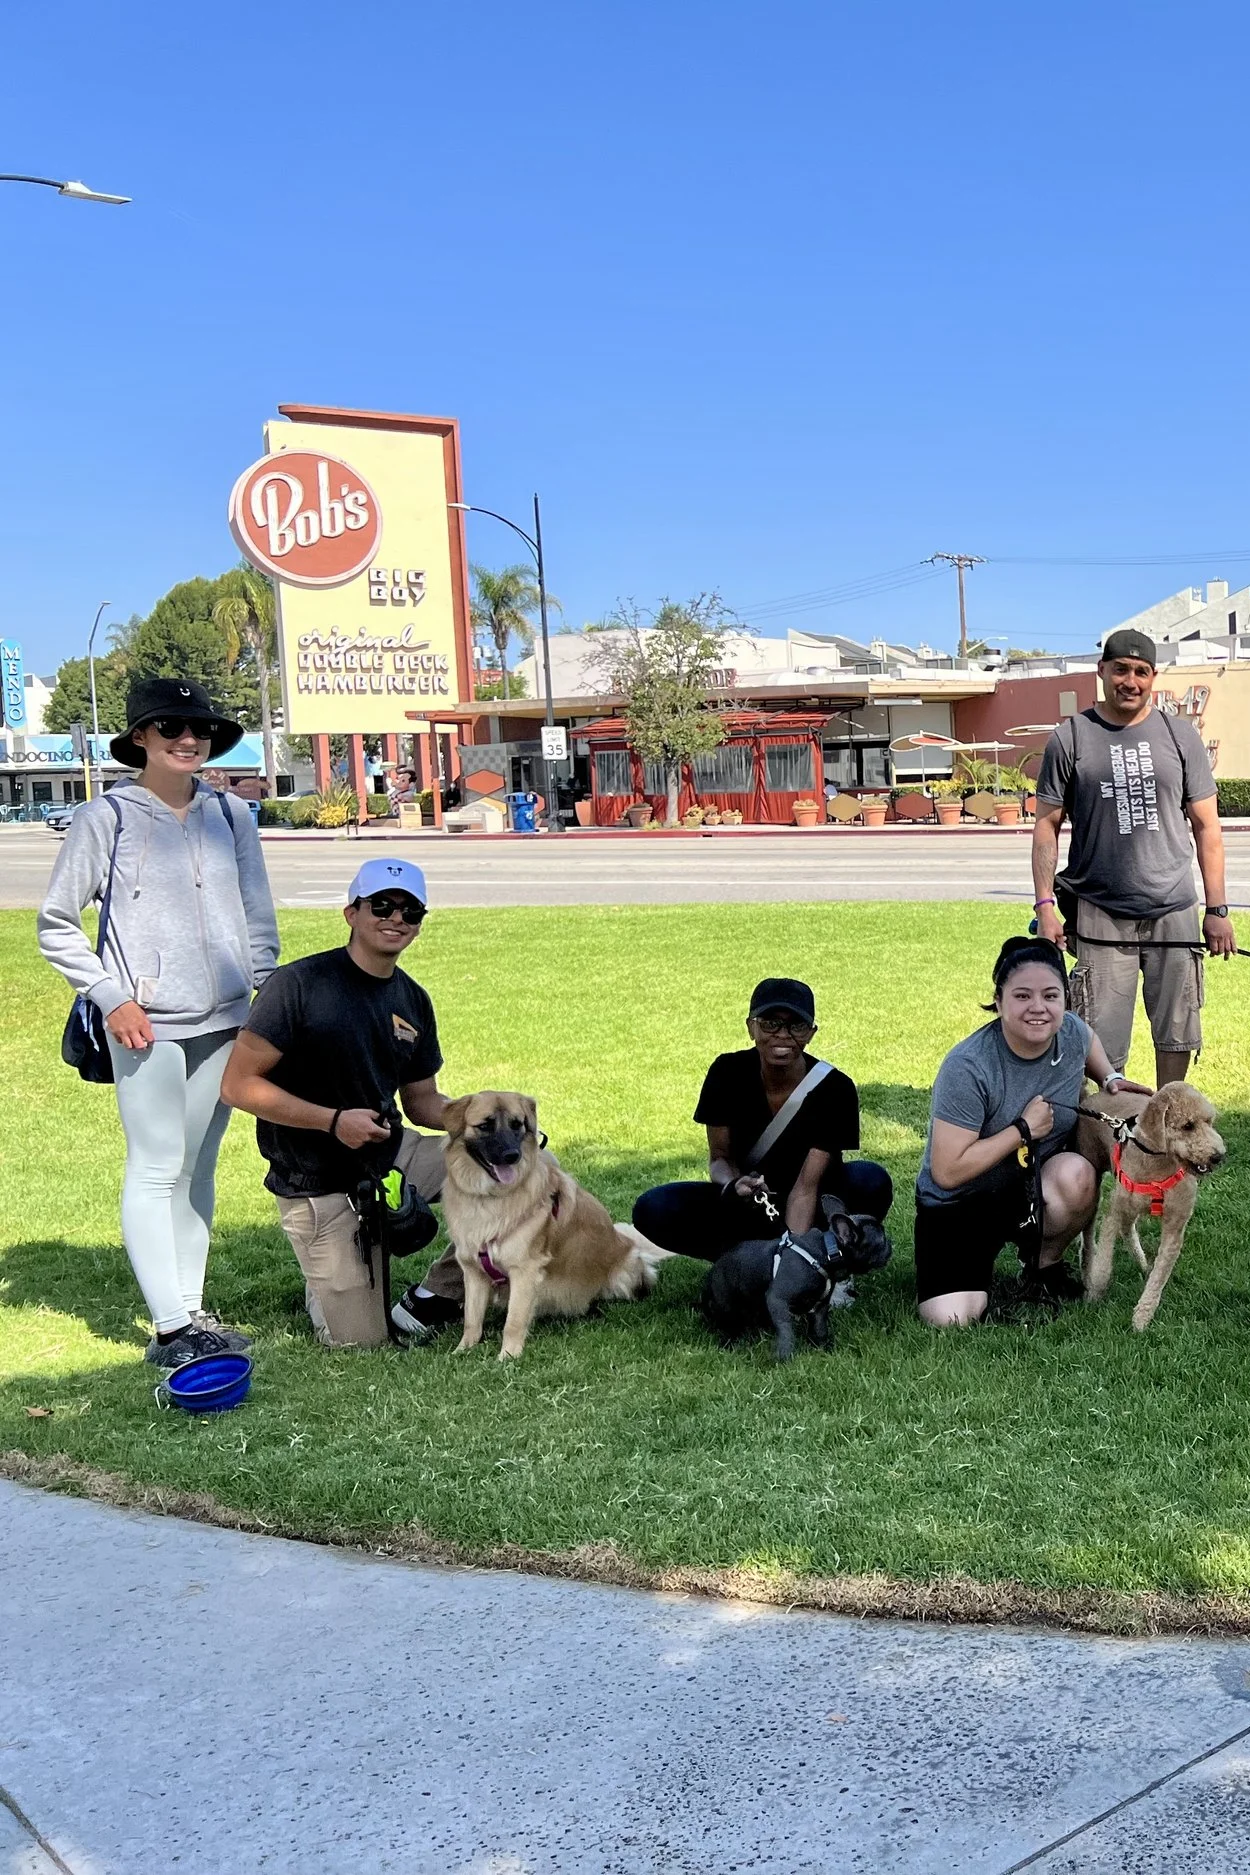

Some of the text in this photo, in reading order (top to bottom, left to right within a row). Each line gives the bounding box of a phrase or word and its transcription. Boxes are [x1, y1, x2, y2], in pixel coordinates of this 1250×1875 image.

[251, 460, 369, 557] Bob's
[369, 568, 426, 587] BIG
[370, 586, 427, 607] BOY
[298, 652, 449, 673] DOUBLE DECK
[2, 646, 23, 721] MENDO
[297, 674, 449, 694] HAMBURGER
[547, 744, 563, 756] 35
[1100, 781, 1114, 798] MY
[1110, 744, 1132, 834] RHODESIAN RIDGEBACK
[1125, 748, 1145, 827] TILTS ITS HEAD
[1138, 741, 1159, 831] JUST LIKE YOU DO
